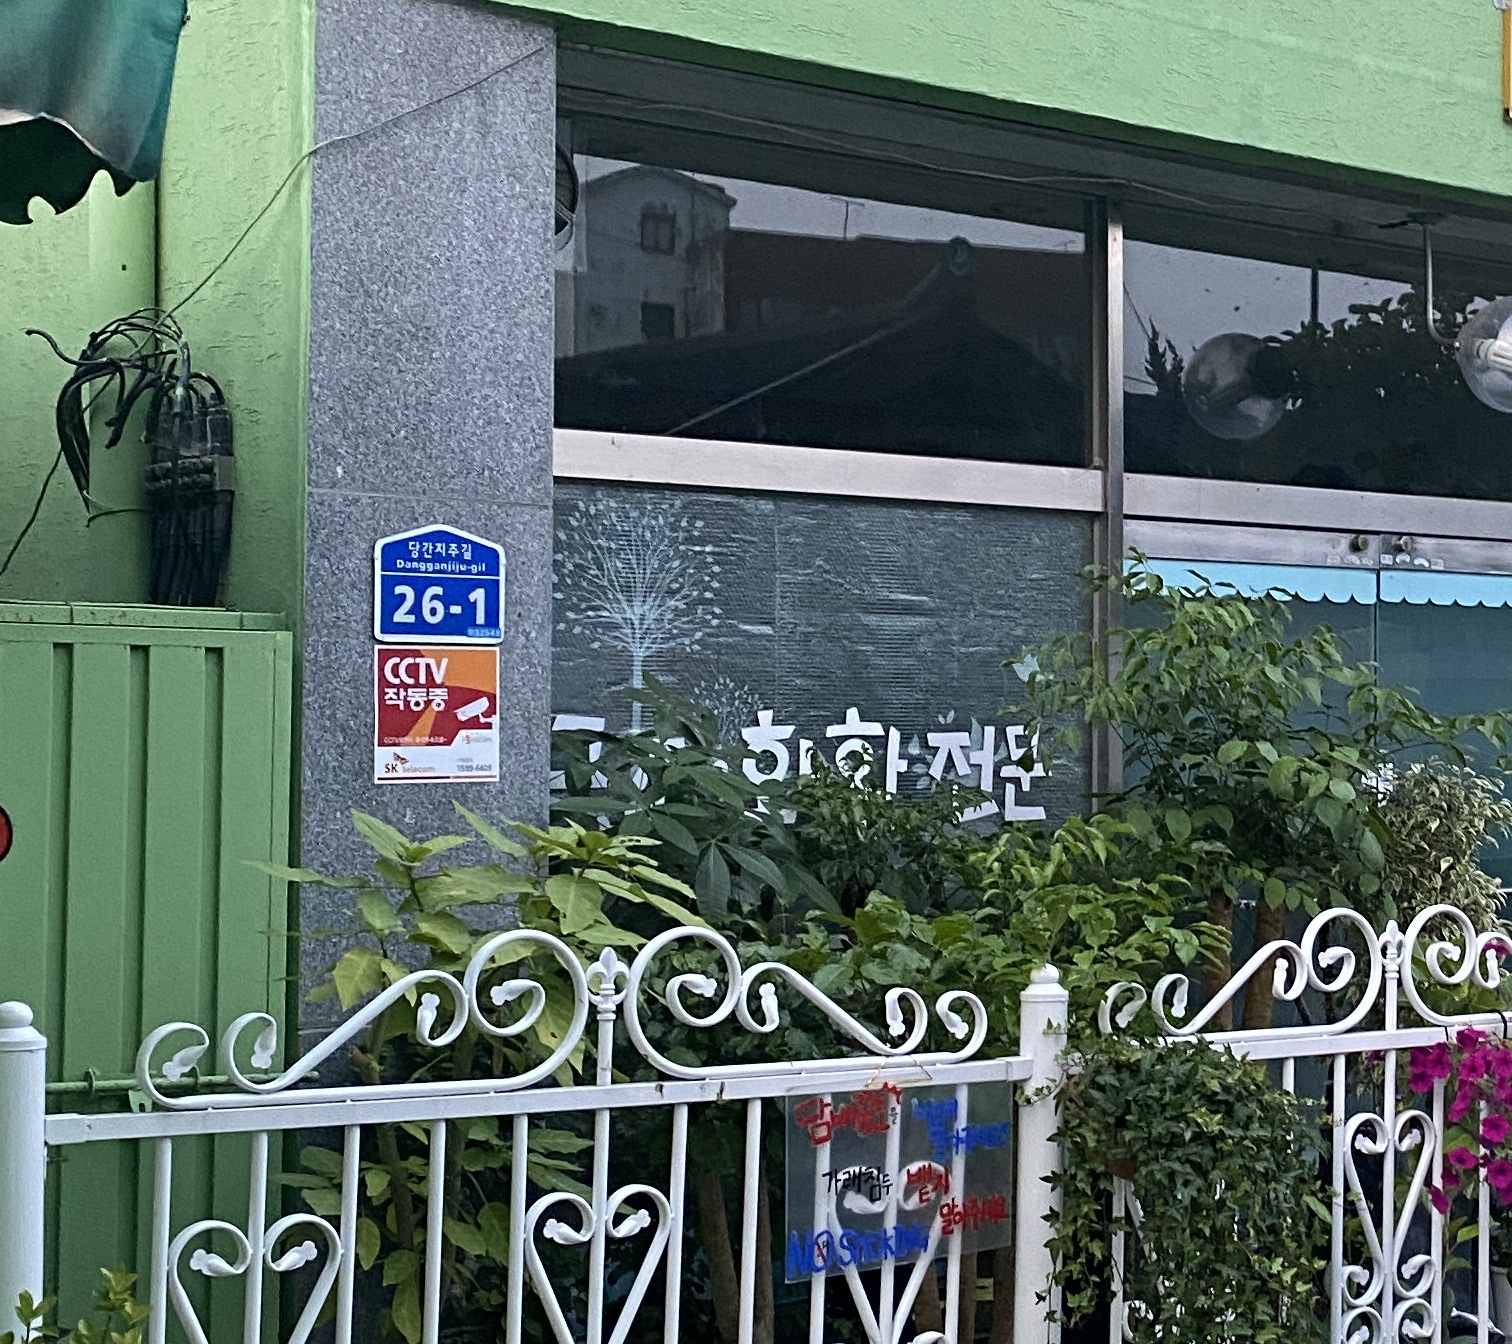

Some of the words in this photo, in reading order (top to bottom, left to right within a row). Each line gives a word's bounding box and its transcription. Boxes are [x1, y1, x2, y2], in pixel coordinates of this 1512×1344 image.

[408, 541, 472, 560] 당간지주길
[396, 559, 486, 574] Dangganjiju-gil
[392, 585, 487, 625] 26-1
[384, 657, 448, 685] CCTV
[384, 687, 448, 712] 작동중
[384, 763, 398, 774] SK
